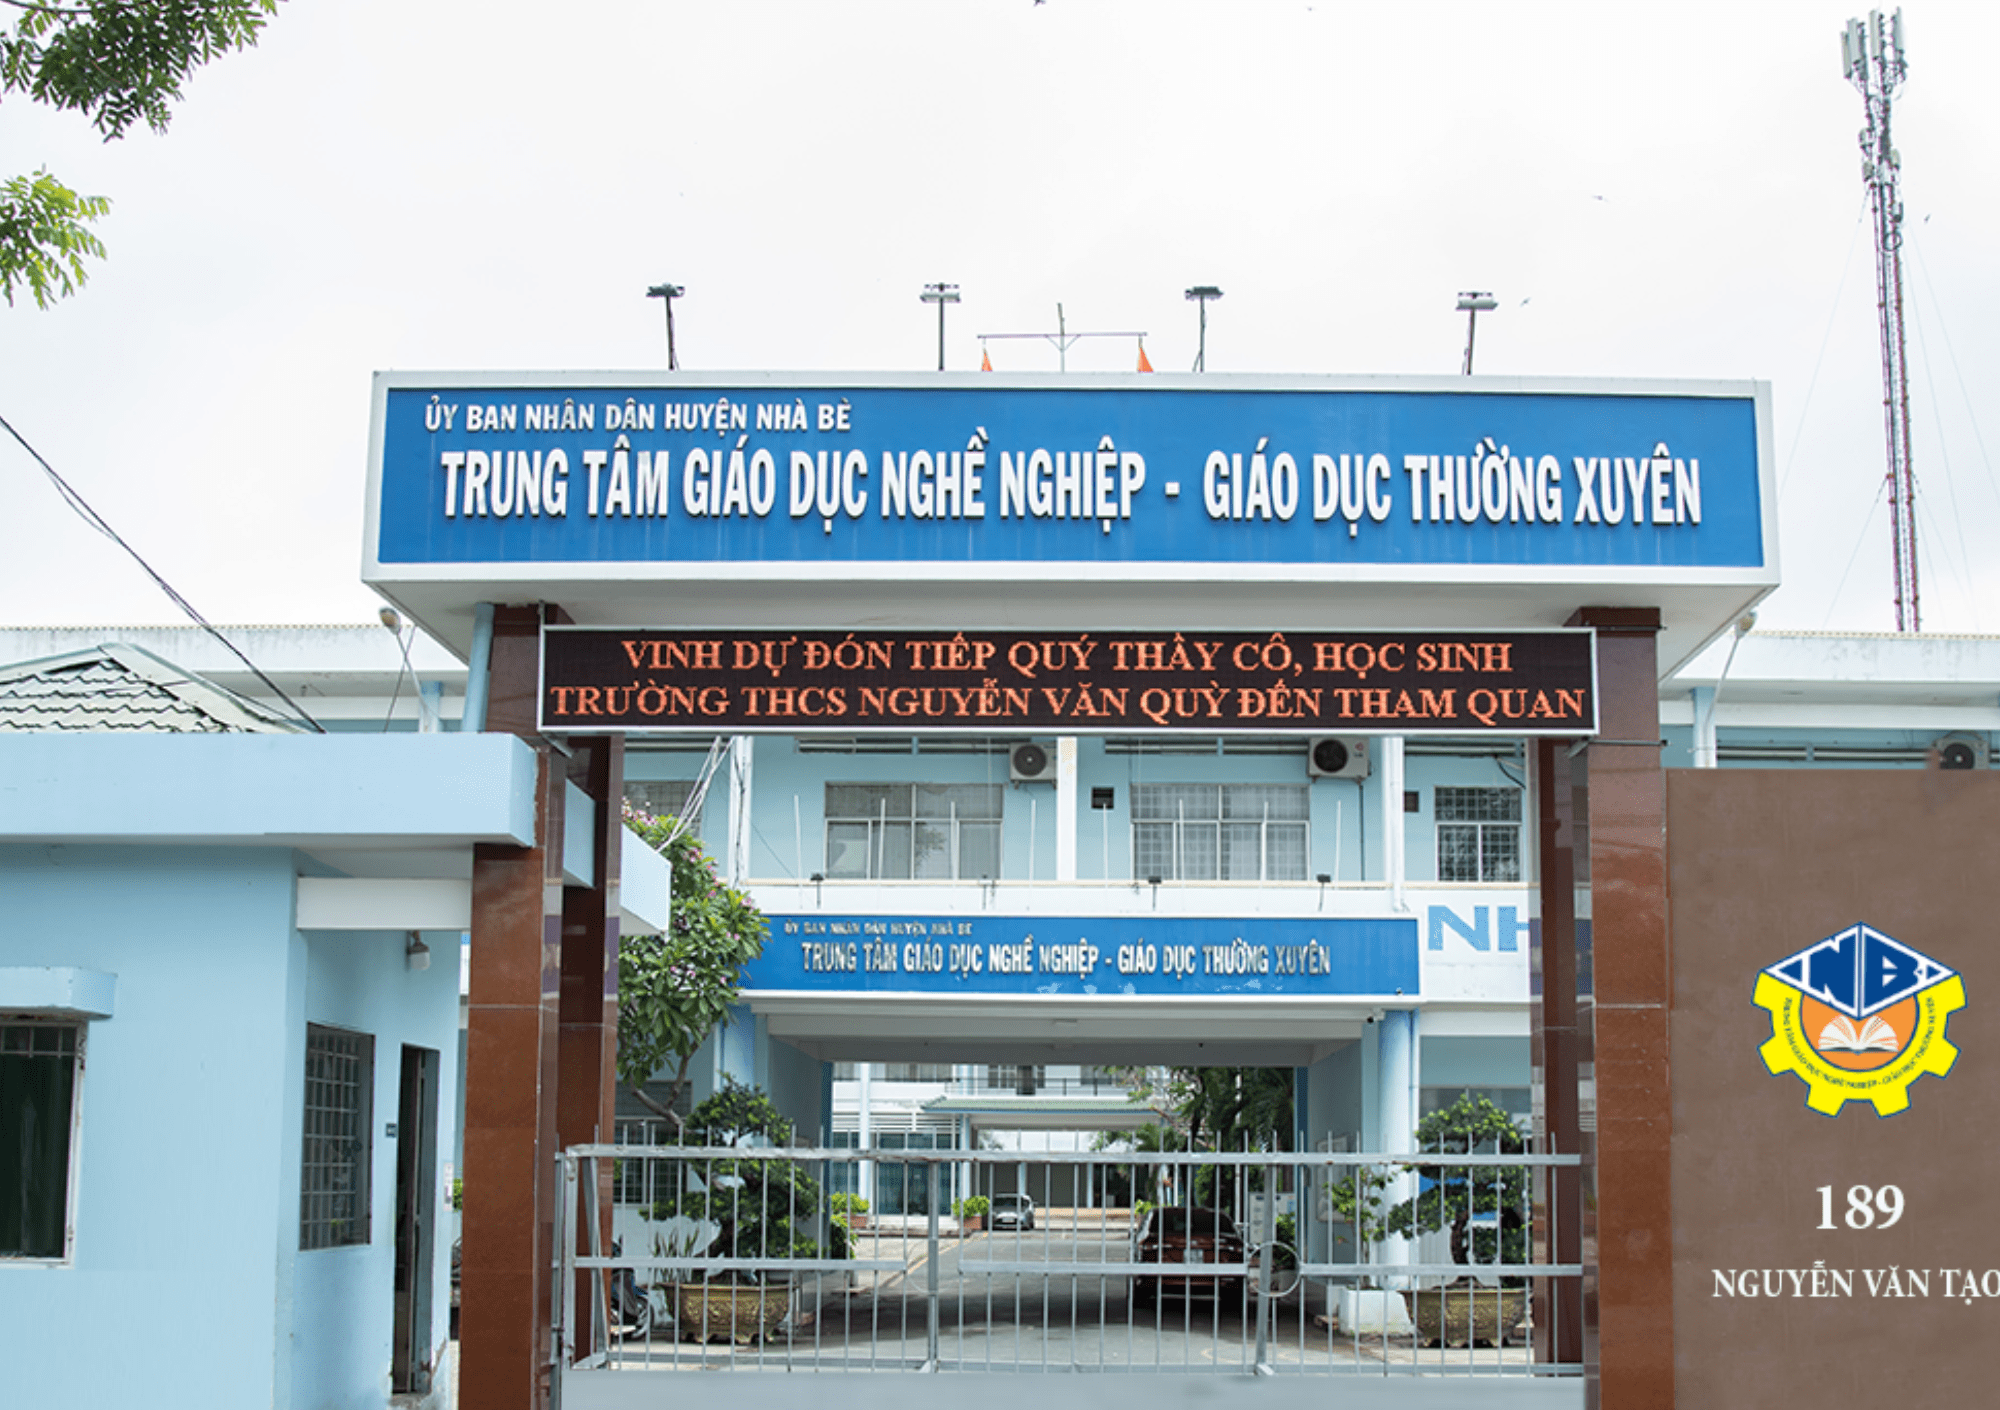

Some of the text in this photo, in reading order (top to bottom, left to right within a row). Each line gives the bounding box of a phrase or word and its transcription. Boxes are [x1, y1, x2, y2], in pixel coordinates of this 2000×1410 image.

[425, 395, 852, 437] ỦY BAN NHÂN DÂN HUYỆN NHÀ BÈ
[441, 426, 1702, 536] TRUNG TÂM GIÁO DỤC NGHỀ NGHIỆP - GIÁO DỤC THƯỜNG XUYÊN
[622, 641, 722, 669] VINH
[732, 636, 800, 677] DỰ
[803, 633, 895, 670] ĐÓN
[1008, 634, 1098, 678] QUÝ
[1232, 632, 1303, 676] CÔ,
[1312, 642, 1405, 679] HỌC
[1416, 642, 1513, 672] SINH
[551, 678, 1585, 726] TRƯỜNG THCS NGUYỄN VĂN QUỲ ĐẾN THAM QUAN
[801, 942, 857, 971] TRUNG
[863, 937, 898, 972] TÂM
[903, 937, 944, 972] GIÁO
[948, 943, 983, 980] DỤC
[988, 933, 1034, 974] NGHỀ
[1039, 937, 1099, 980] NGHIỆP
[1117, 938, 1157, 974] GIÁO
[1162, 945, 1197, 980] DỤC
[1202, 937, 1269, 975] THƯỜNG
[1274, 938, 1331, 974] XUYÊN
[1815, 1184, 1905, 1230] 189
[1712, 1260, 2000, 1305] NGUYỄN VĂN TẠO
